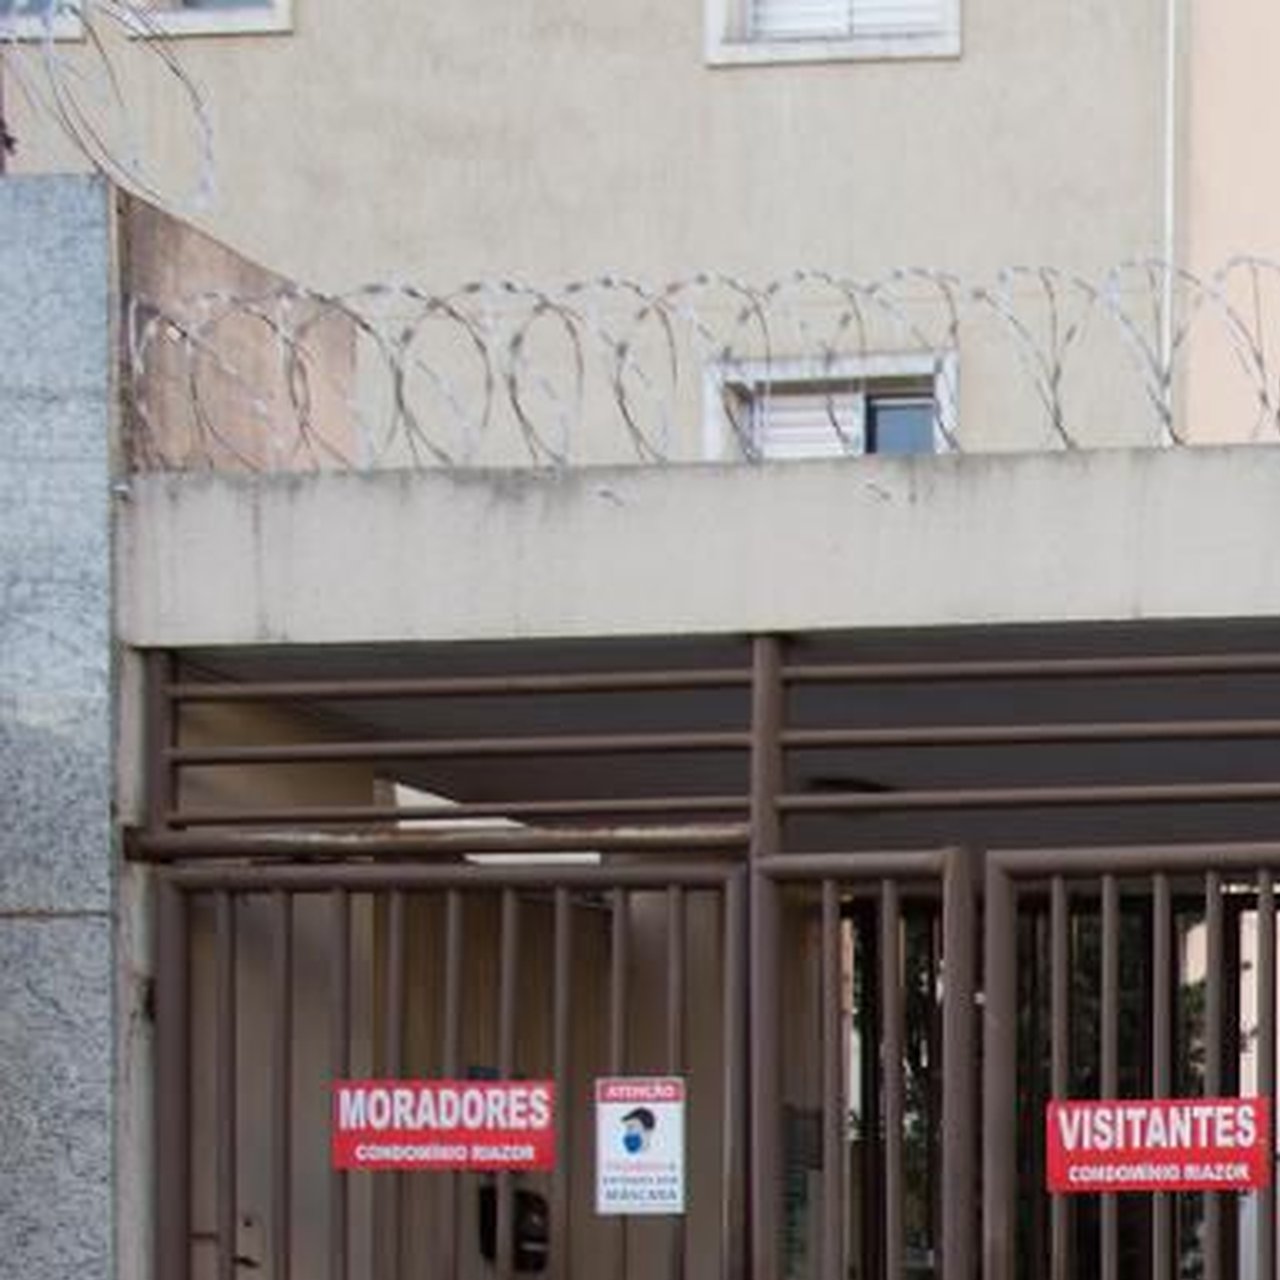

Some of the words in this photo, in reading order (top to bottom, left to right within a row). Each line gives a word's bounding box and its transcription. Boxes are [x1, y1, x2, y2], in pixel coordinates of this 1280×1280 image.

[339, 1088, 549, 1130] MORADORES
[1058, 1105, 1256, 1150] VISITANTES
[1183, 1162, 1250, 1182] RIAZOR
